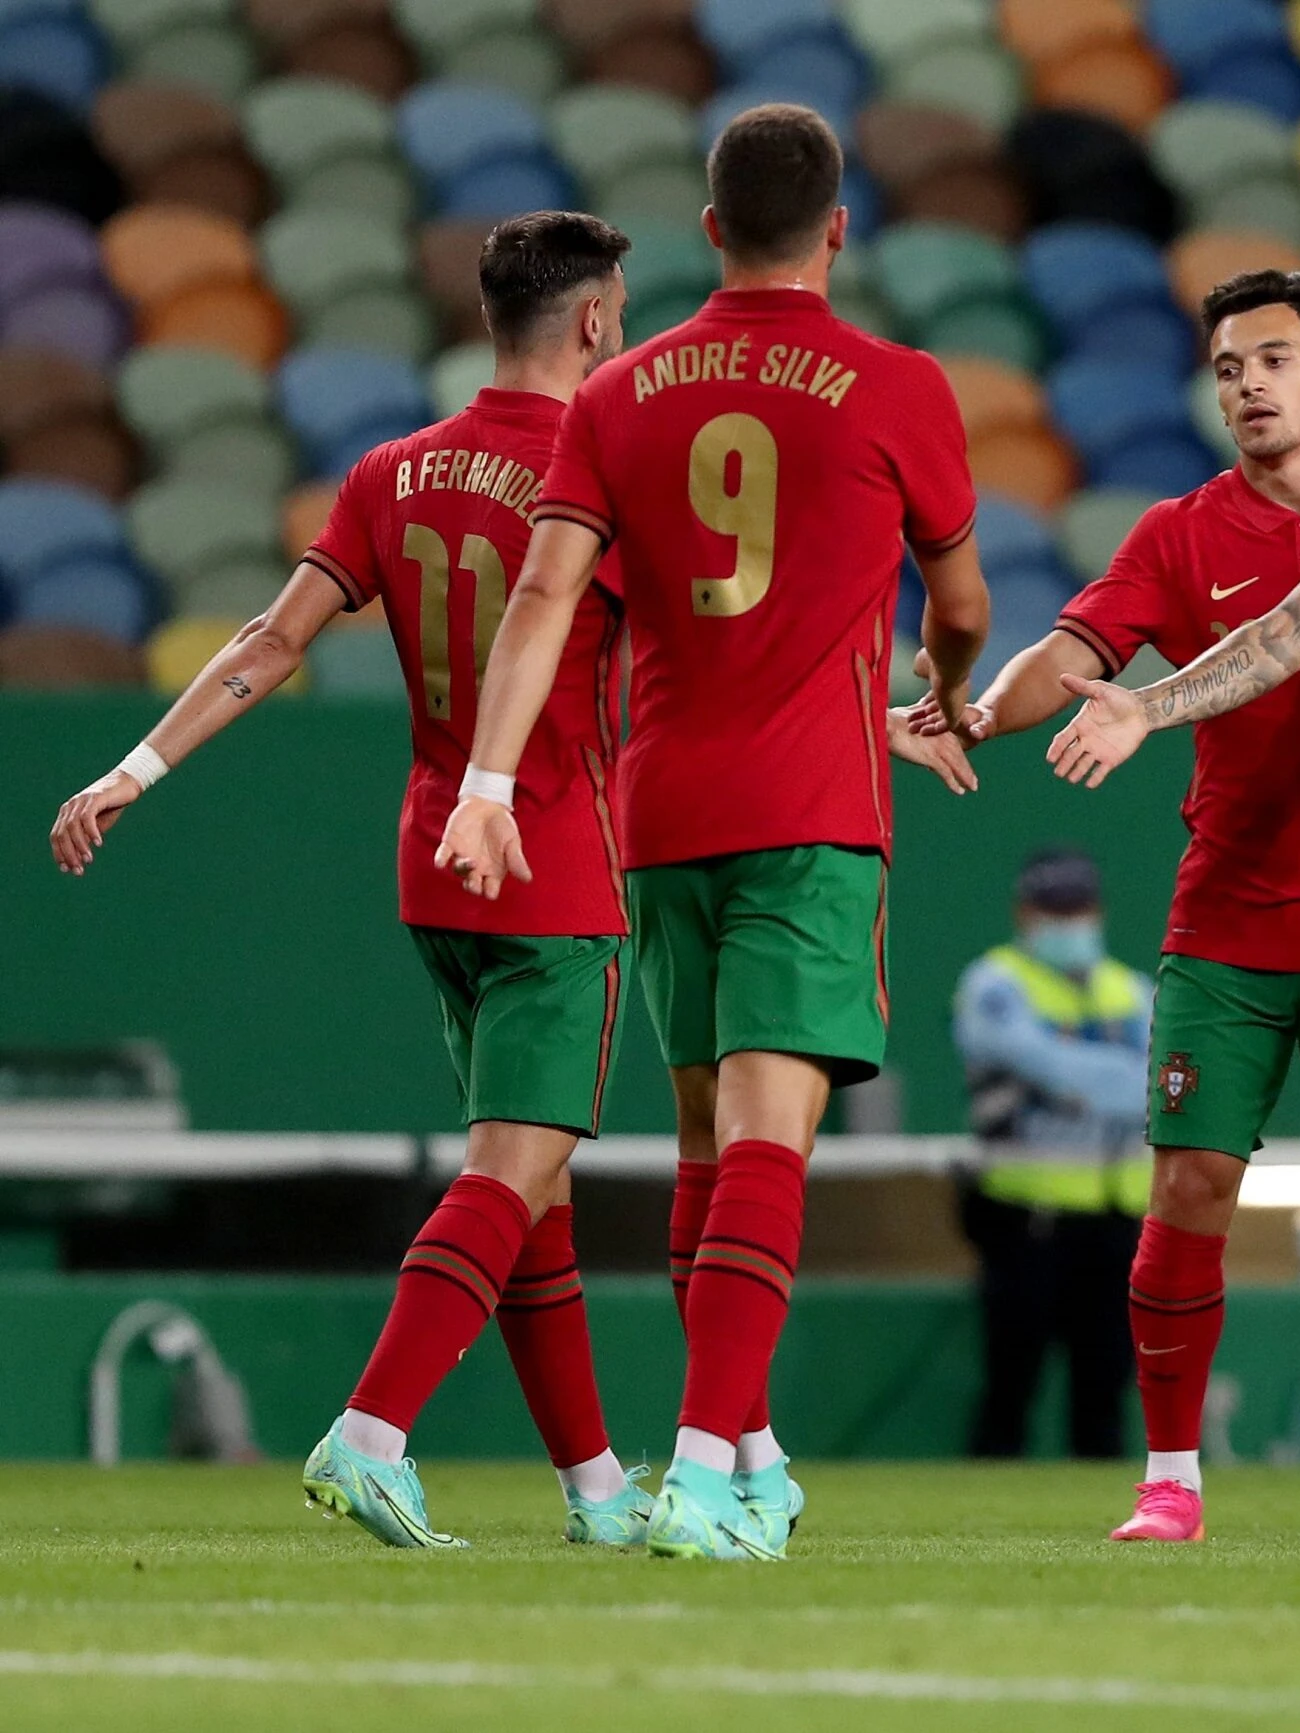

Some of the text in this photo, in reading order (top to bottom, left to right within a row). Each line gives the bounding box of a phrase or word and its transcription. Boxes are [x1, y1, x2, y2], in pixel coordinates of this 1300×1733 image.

[633, 333, 858, 409] ANDRÉ SILVA
[396, 459, 415, 502] B.
[688, 411, 779, 618] 9
[401, 522, 508, 722] 11
